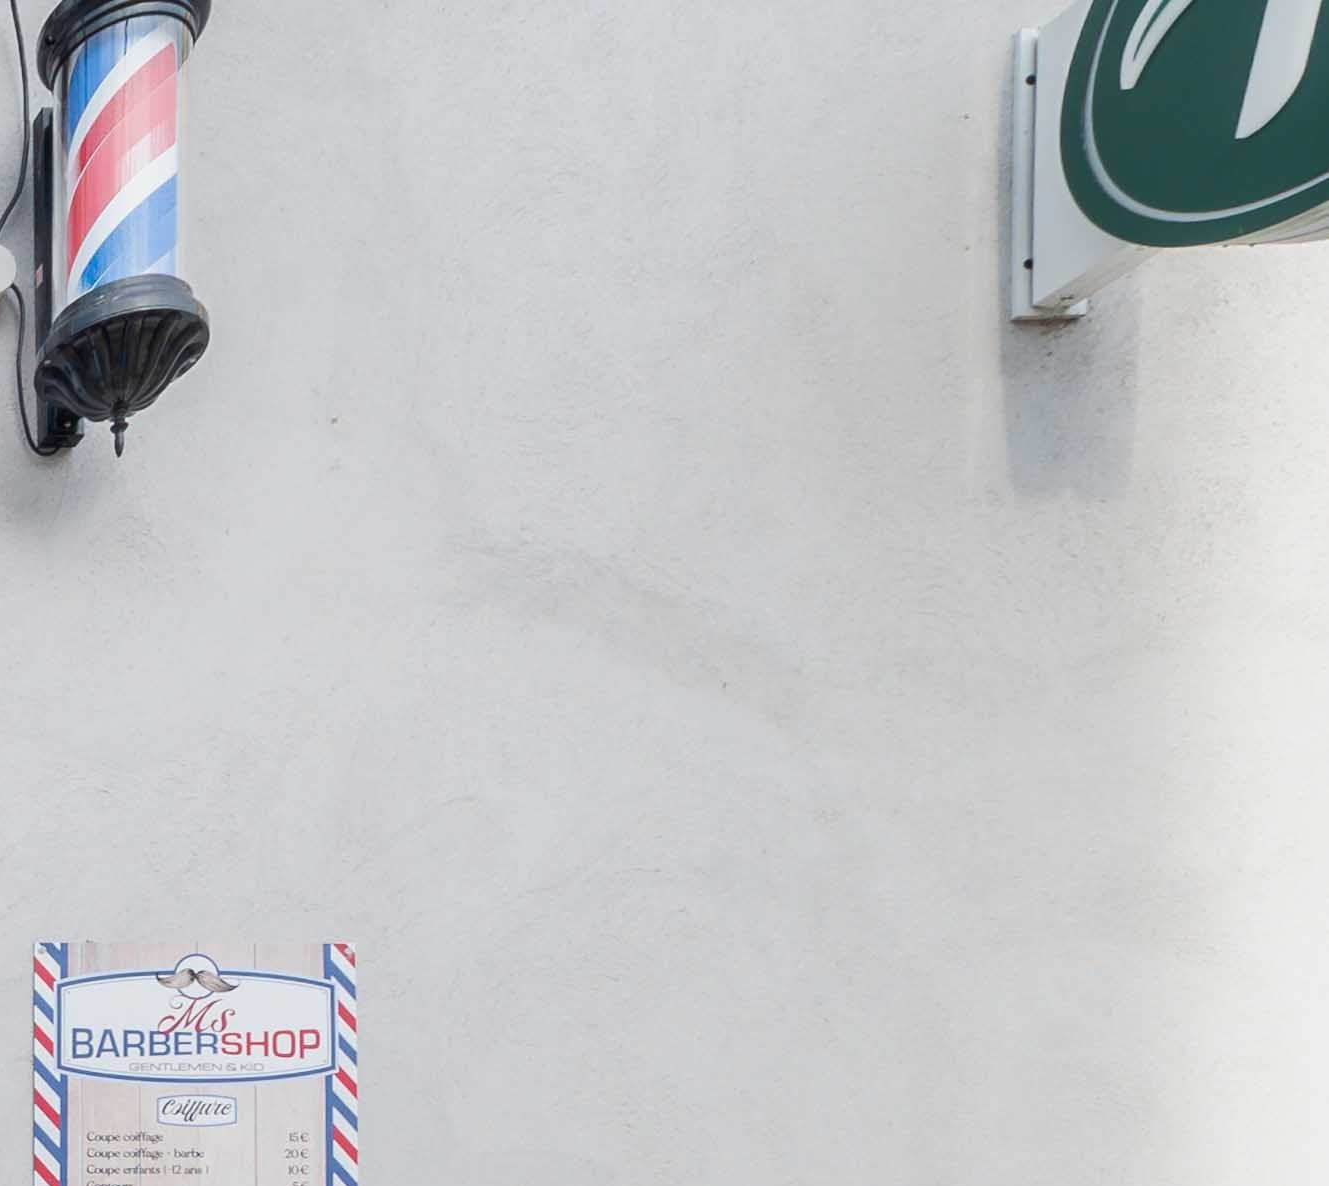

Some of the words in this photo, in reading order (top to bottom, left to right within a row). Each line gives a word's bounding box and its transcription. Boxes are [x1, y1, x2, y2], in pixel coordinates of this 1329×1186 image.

[157, 996, 236, 1035] Ms
[71, 1027, 321, 1060] BARBERSHOP
[128, 1062, 223, 1072] GENTLEMEN
[225, 1062, 237, 1072] &
[240, 1062, 265, 1072] KID
[161, 1098, 232, 1123] Coiffure
[86, 1131, 120, 1144] Coupe
[86, 1147, 120, 1160] Coupe
[173, 1148, 205, 1159] barbe
[86, 1164, 120, 1176] Coupe
[123, 1164, 160, 1175] enfants
